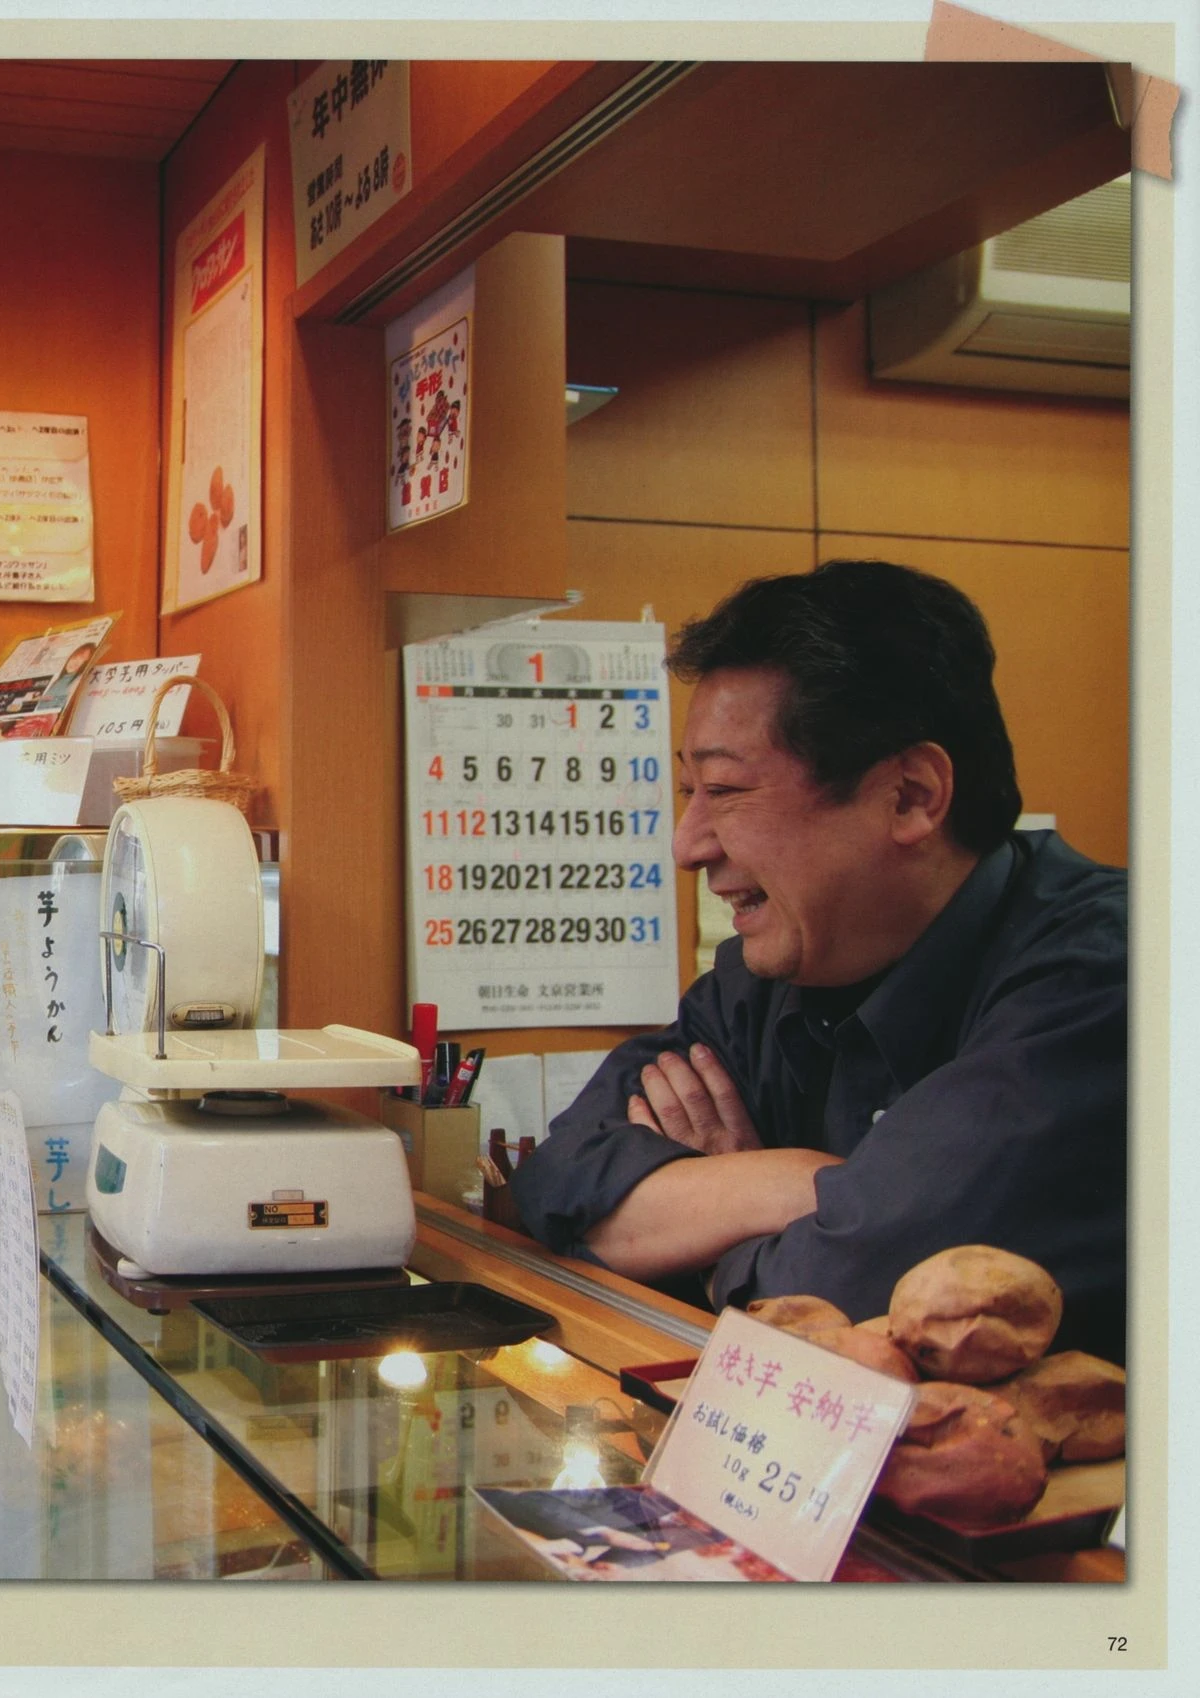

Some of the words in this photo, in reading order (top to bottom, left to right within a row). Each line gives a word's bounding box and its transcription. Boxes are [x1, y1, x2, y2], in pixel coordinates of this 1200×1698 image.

[528, 652, 544, 683] 1
[97, 719, 145, 736] 105円
[497, 714, 513, 728] 30
[530, 714, 545, 728] 31
[566, 703, 576, 728] 1
[600, 704, 614, 729] 2
[635, 704, 649, 729] 3
[429, 756, 443, 781] 4
[464, 756, 477, 782] 5
[498, 756, 512, 782] 6
[532, 757, 545, 782] 7
[567, 757, 581, 782] 8
[601, 757, 616, 782] 9
[629, 757, 658, 782] 10
[423, 810, 448, 836] 11
[457, 810, 485, 836] 12
[491, 810, 520, 836] 13
[526, 811, 555, 835] 14
[560, 811, 589, 836] 15
[595, 810, 624, 836] 16
[629, 810, 659, 835] 17
[424, 865, 452, 891] 18
[458, 864, 487, 890] 19
[491, 865, 521, 890] 20
[525, 864, 551, 889] 21
[560, 864, 590, 889] 22
[595, 864, 625, 889] 23
[630, 864, 662, 888] 24
[426, 920, 453, 945] 25
[458, 919, 487, 944] 26
[492, 919, 521, 944] 27
[526, 918, 556, 943] 28
[561, 918, 591, 943] 29
[595, 917, 626, 942] 30
[631, 917, 659, 942] 31
[37, 891, 66, 1043] 芋ようかん
[716, 1344, 784, 1398] 焼き芋
[786, 1377, 876, 1441] 安納芋
[693, 1401, 767, 1454] お試し価格
